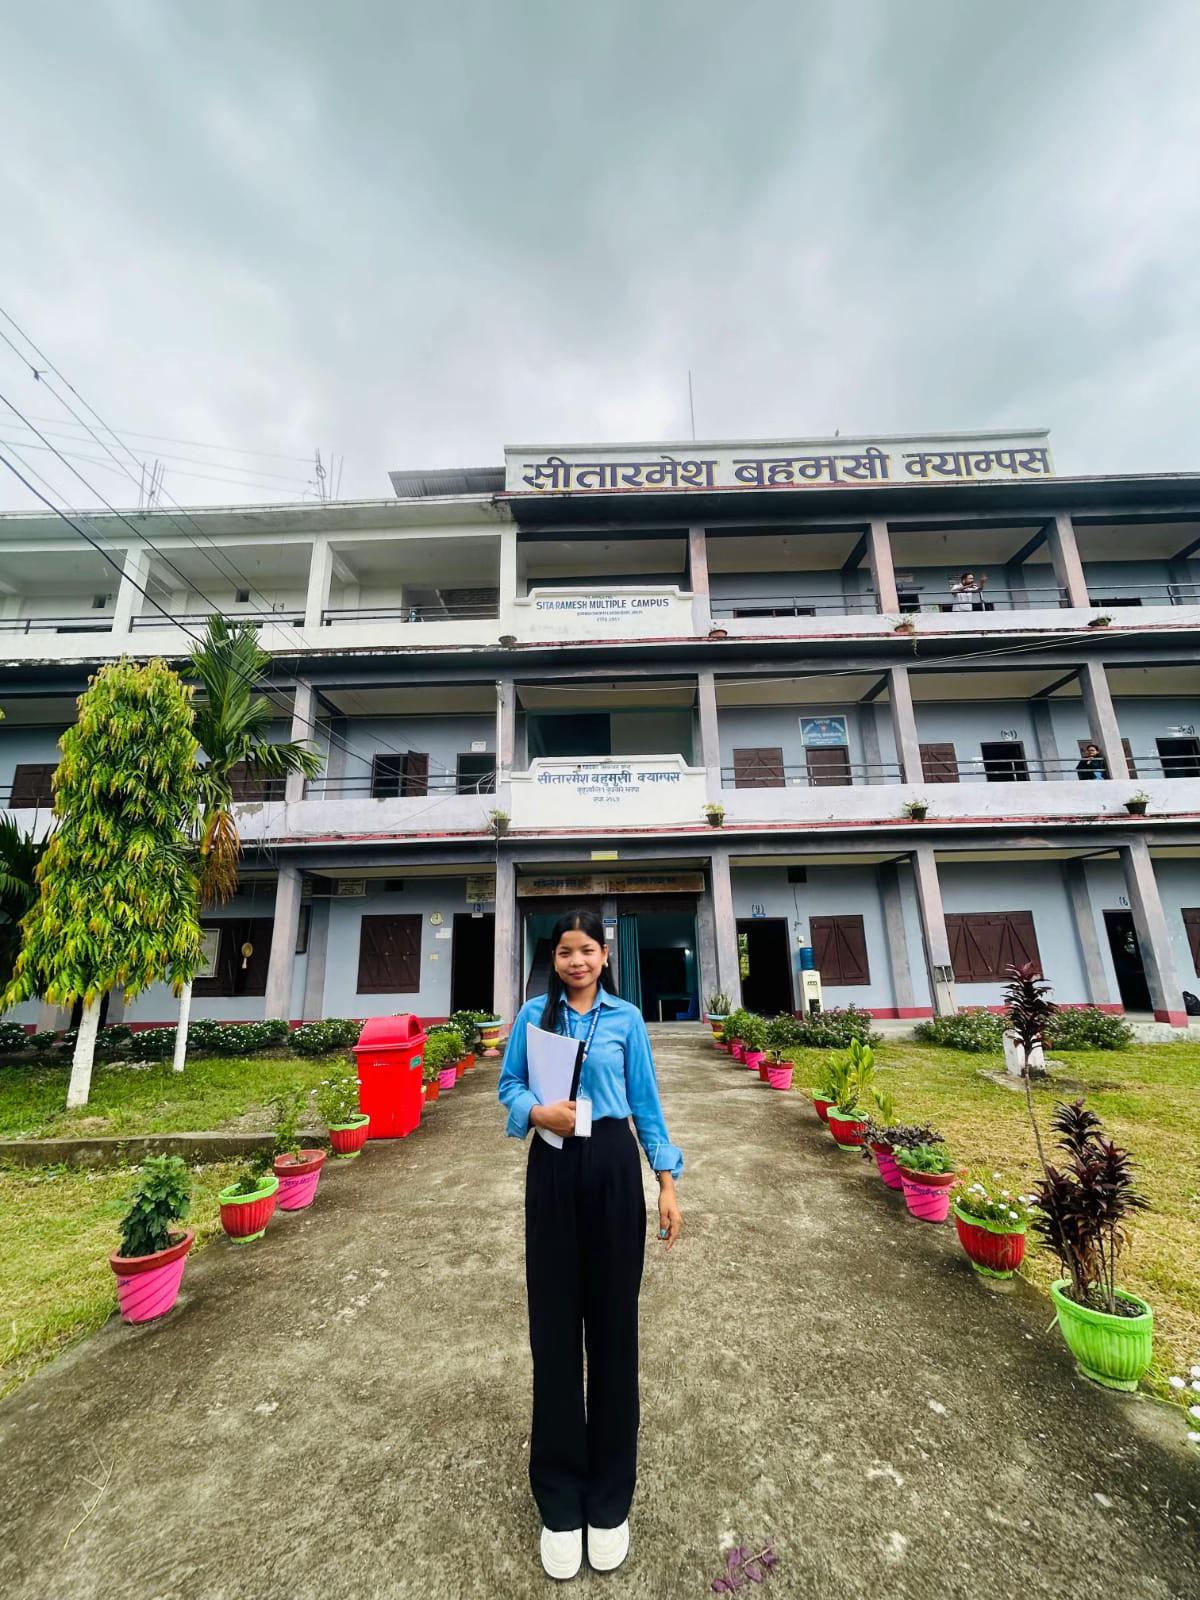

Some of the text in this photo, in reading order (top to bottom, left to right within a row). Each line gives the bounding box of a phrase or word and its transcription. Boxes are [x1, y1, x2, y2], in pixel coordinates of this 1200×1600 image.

[522, 455, 718, 489] सीतारमेश
[902, 447, 1050, 479] क्याम्पस
[589, 599, 627, 609] MULTIPLE
[631, 598, 669, 608] CAMPUS
[537, 770, 589, 785] सीतारमेश
[637, 772, 681, 783] क्याम्पस
